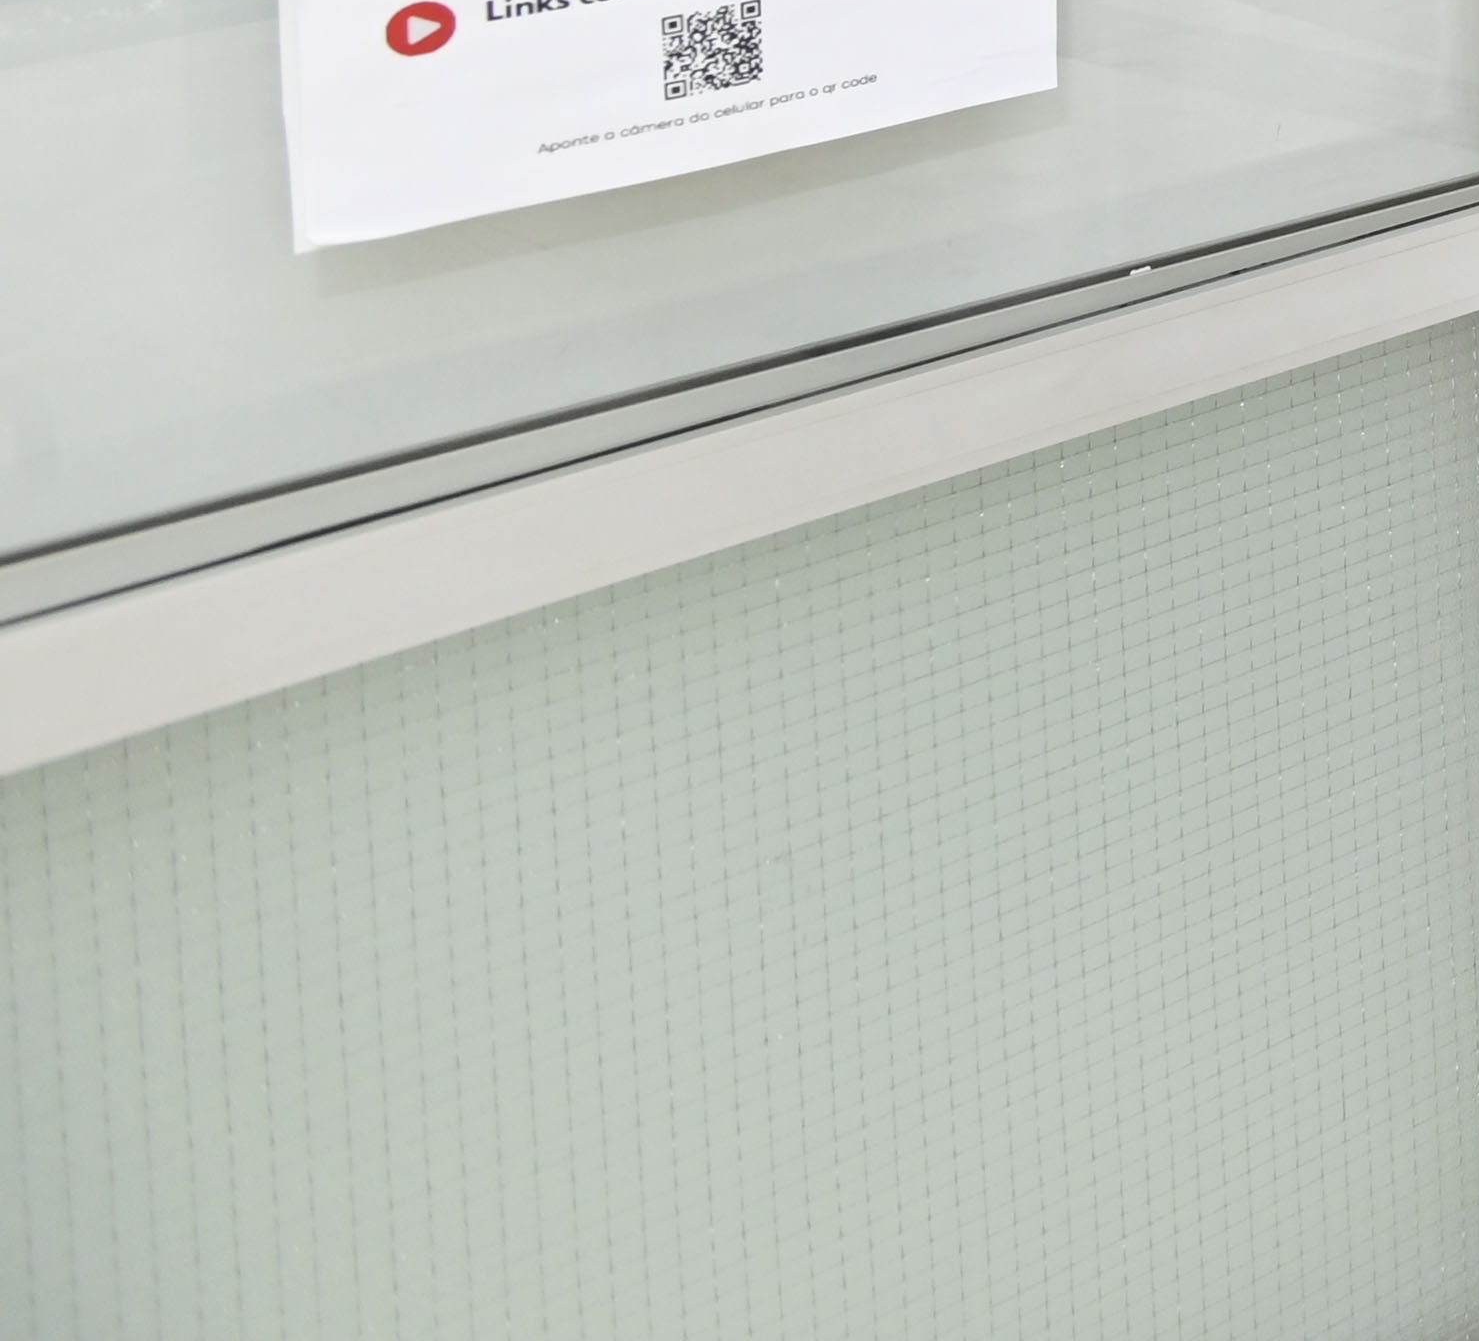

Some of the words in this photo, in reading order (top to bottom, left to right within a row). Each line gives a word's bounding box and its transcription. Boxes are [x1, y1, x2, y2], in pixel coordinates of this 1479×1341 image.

[537, 133, 600, 155] Aponte
[604, 129, 616, 141] a
[620, 116, 685, 139] câmera
[689, 109, 710, 125] do
[714, 98, 765, 120] celular
[769, 89, 806, 109] para
[809, 86, 819, 97] o
[822, 81, 837, 95] qr
[841, 71, 878, 90] code
